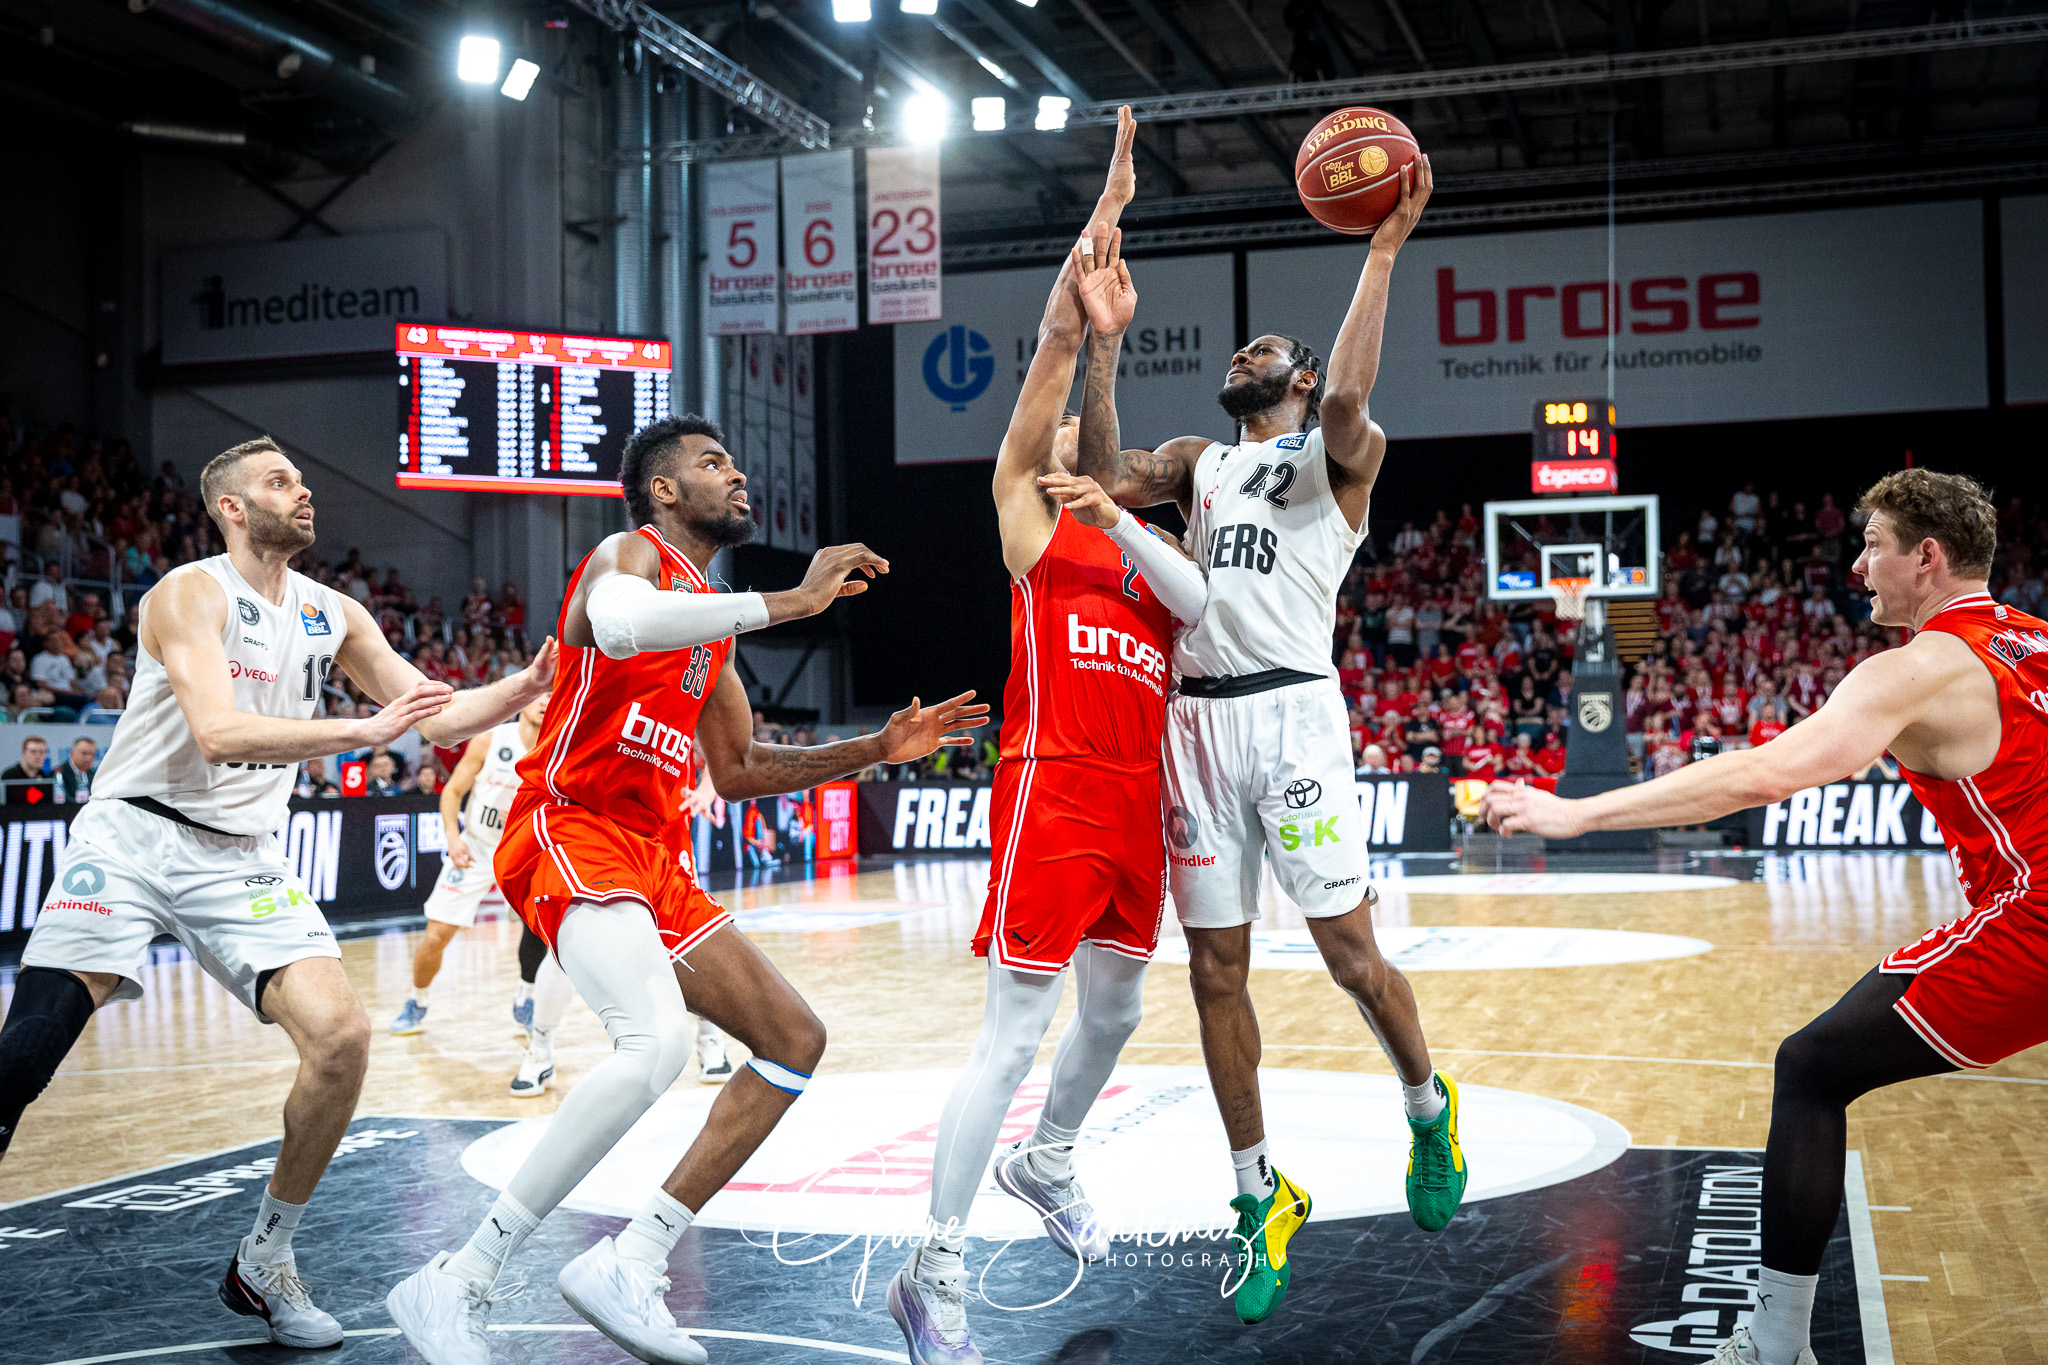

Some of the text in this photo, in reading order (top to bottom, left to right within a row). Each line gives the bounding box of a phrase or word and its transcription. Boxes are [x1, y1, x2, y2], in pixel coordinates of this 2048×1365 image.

[1306, 115, 1388, 158] SPALDING
[1330, 169, 1357, 187] BBL
[727, 220, 757, 269] 5
[803, 218, 836, 268] 6
[872, 206, 937, 257] 23
[709, 273, 774, 291] brose
[786, 270, 853, 290] brose
[871, 260, 937, 278] brose
[228, 283, 419, 327] mediteam
[1436, 266, 1762, 347] brose
[1134, 356, 1202, 378] GMBH
[1440, 342, 1763, 380] Technik für Automobile
[1279, 439, 1303, 449] BBL
[1566, 429, 1600, 457] 14
[1239, 460, 1297, 510] 42
[1538, 464, 1607, 489] tipico
[1068, 613, 1166, 681] brose
[680, 645, 713, 699] 35
[1070, 658, 1116, 673] Technik
[621, 701, 692, 764] bros
[344, 765, 362, 789] 5
[1279, 808, 1323, 824] Autohaus
[1762, 783, 1912, 846] FREAK
[1324, 878, 1356, 890] CRAFT
